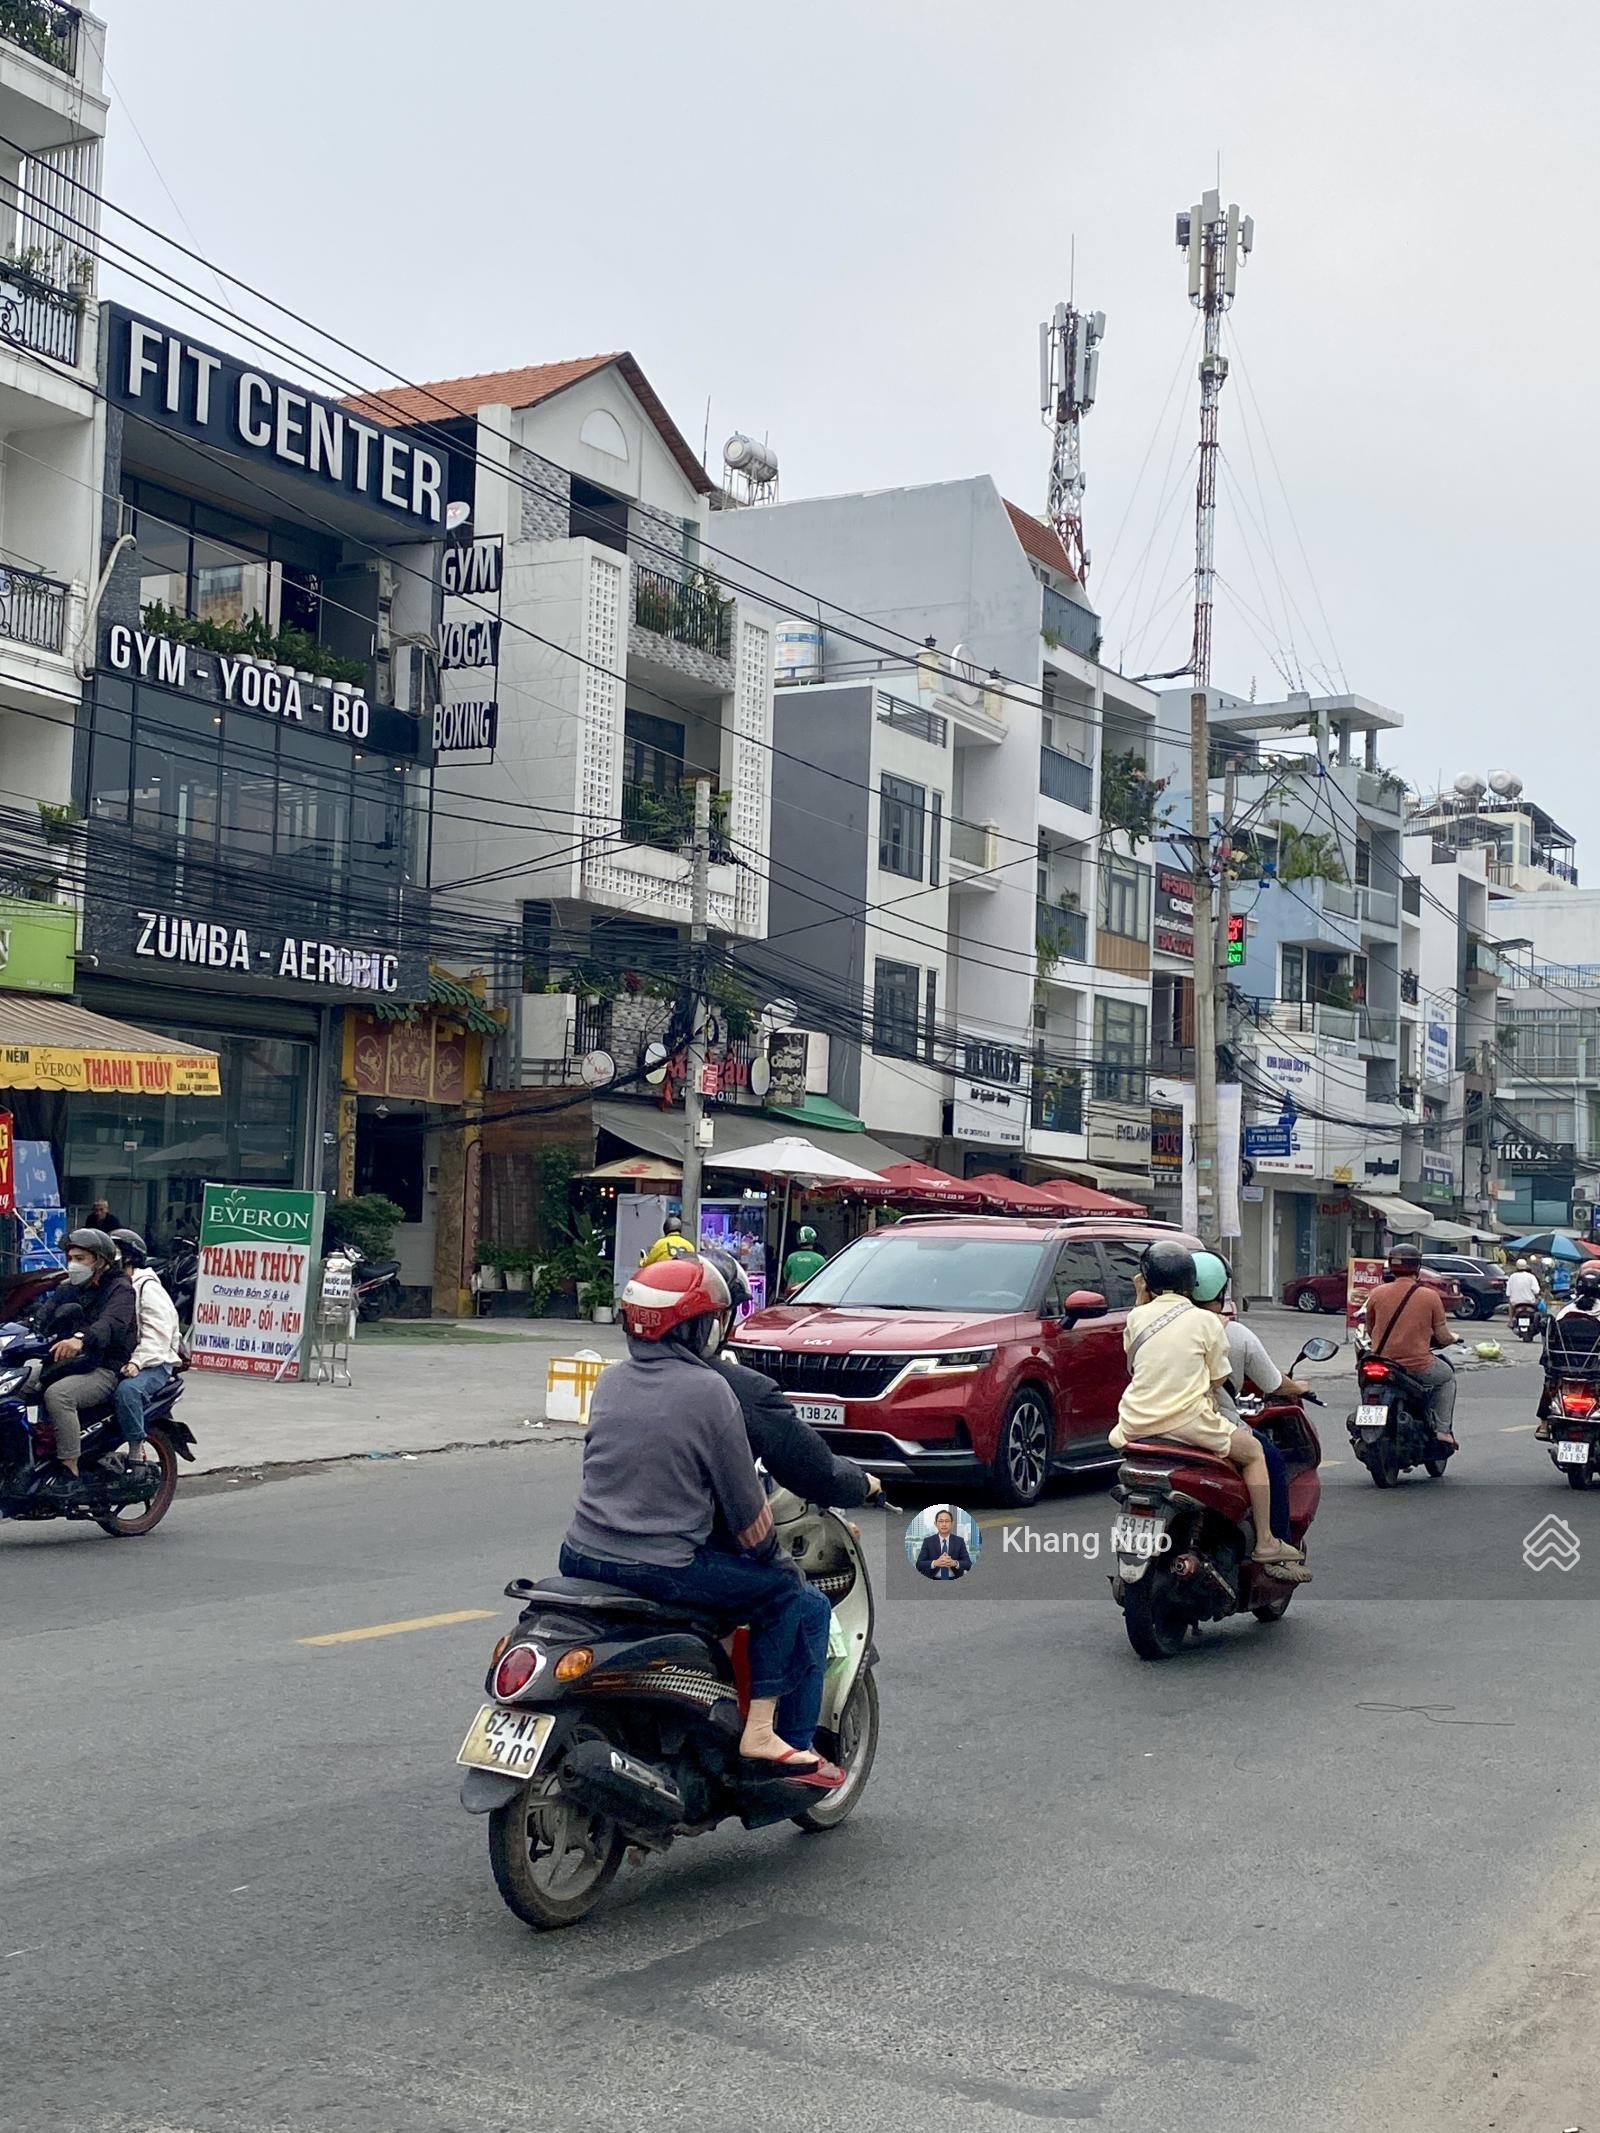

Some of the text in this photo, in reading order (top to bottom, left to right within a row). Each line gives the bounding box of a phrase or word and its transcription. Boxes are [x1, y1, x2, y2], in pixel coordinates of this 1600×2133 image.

[128, 320, 442, 522] FIT CENTER
[442, 546, 498, 592] GYM
[437, 619, 493, 668] YOGA
[110, 625, 370, 739] GYM YOGA BO
[431, 701, 491, 750] BOXING
[136, 911, 399, 993] ZUMBA AEROBIC
[6, 1049, 29, 1066] NỆM
[35, 1061, 82, 1077] EVERON
[83, 1057, 133, 1087] THANH
[209, 1206, 310, 1229] EVERON
[203, 1247, 257, 1280] THANH
[227, 1306, 252, 1329] DRAP
[261, 1341, 274, 1354] KIM
